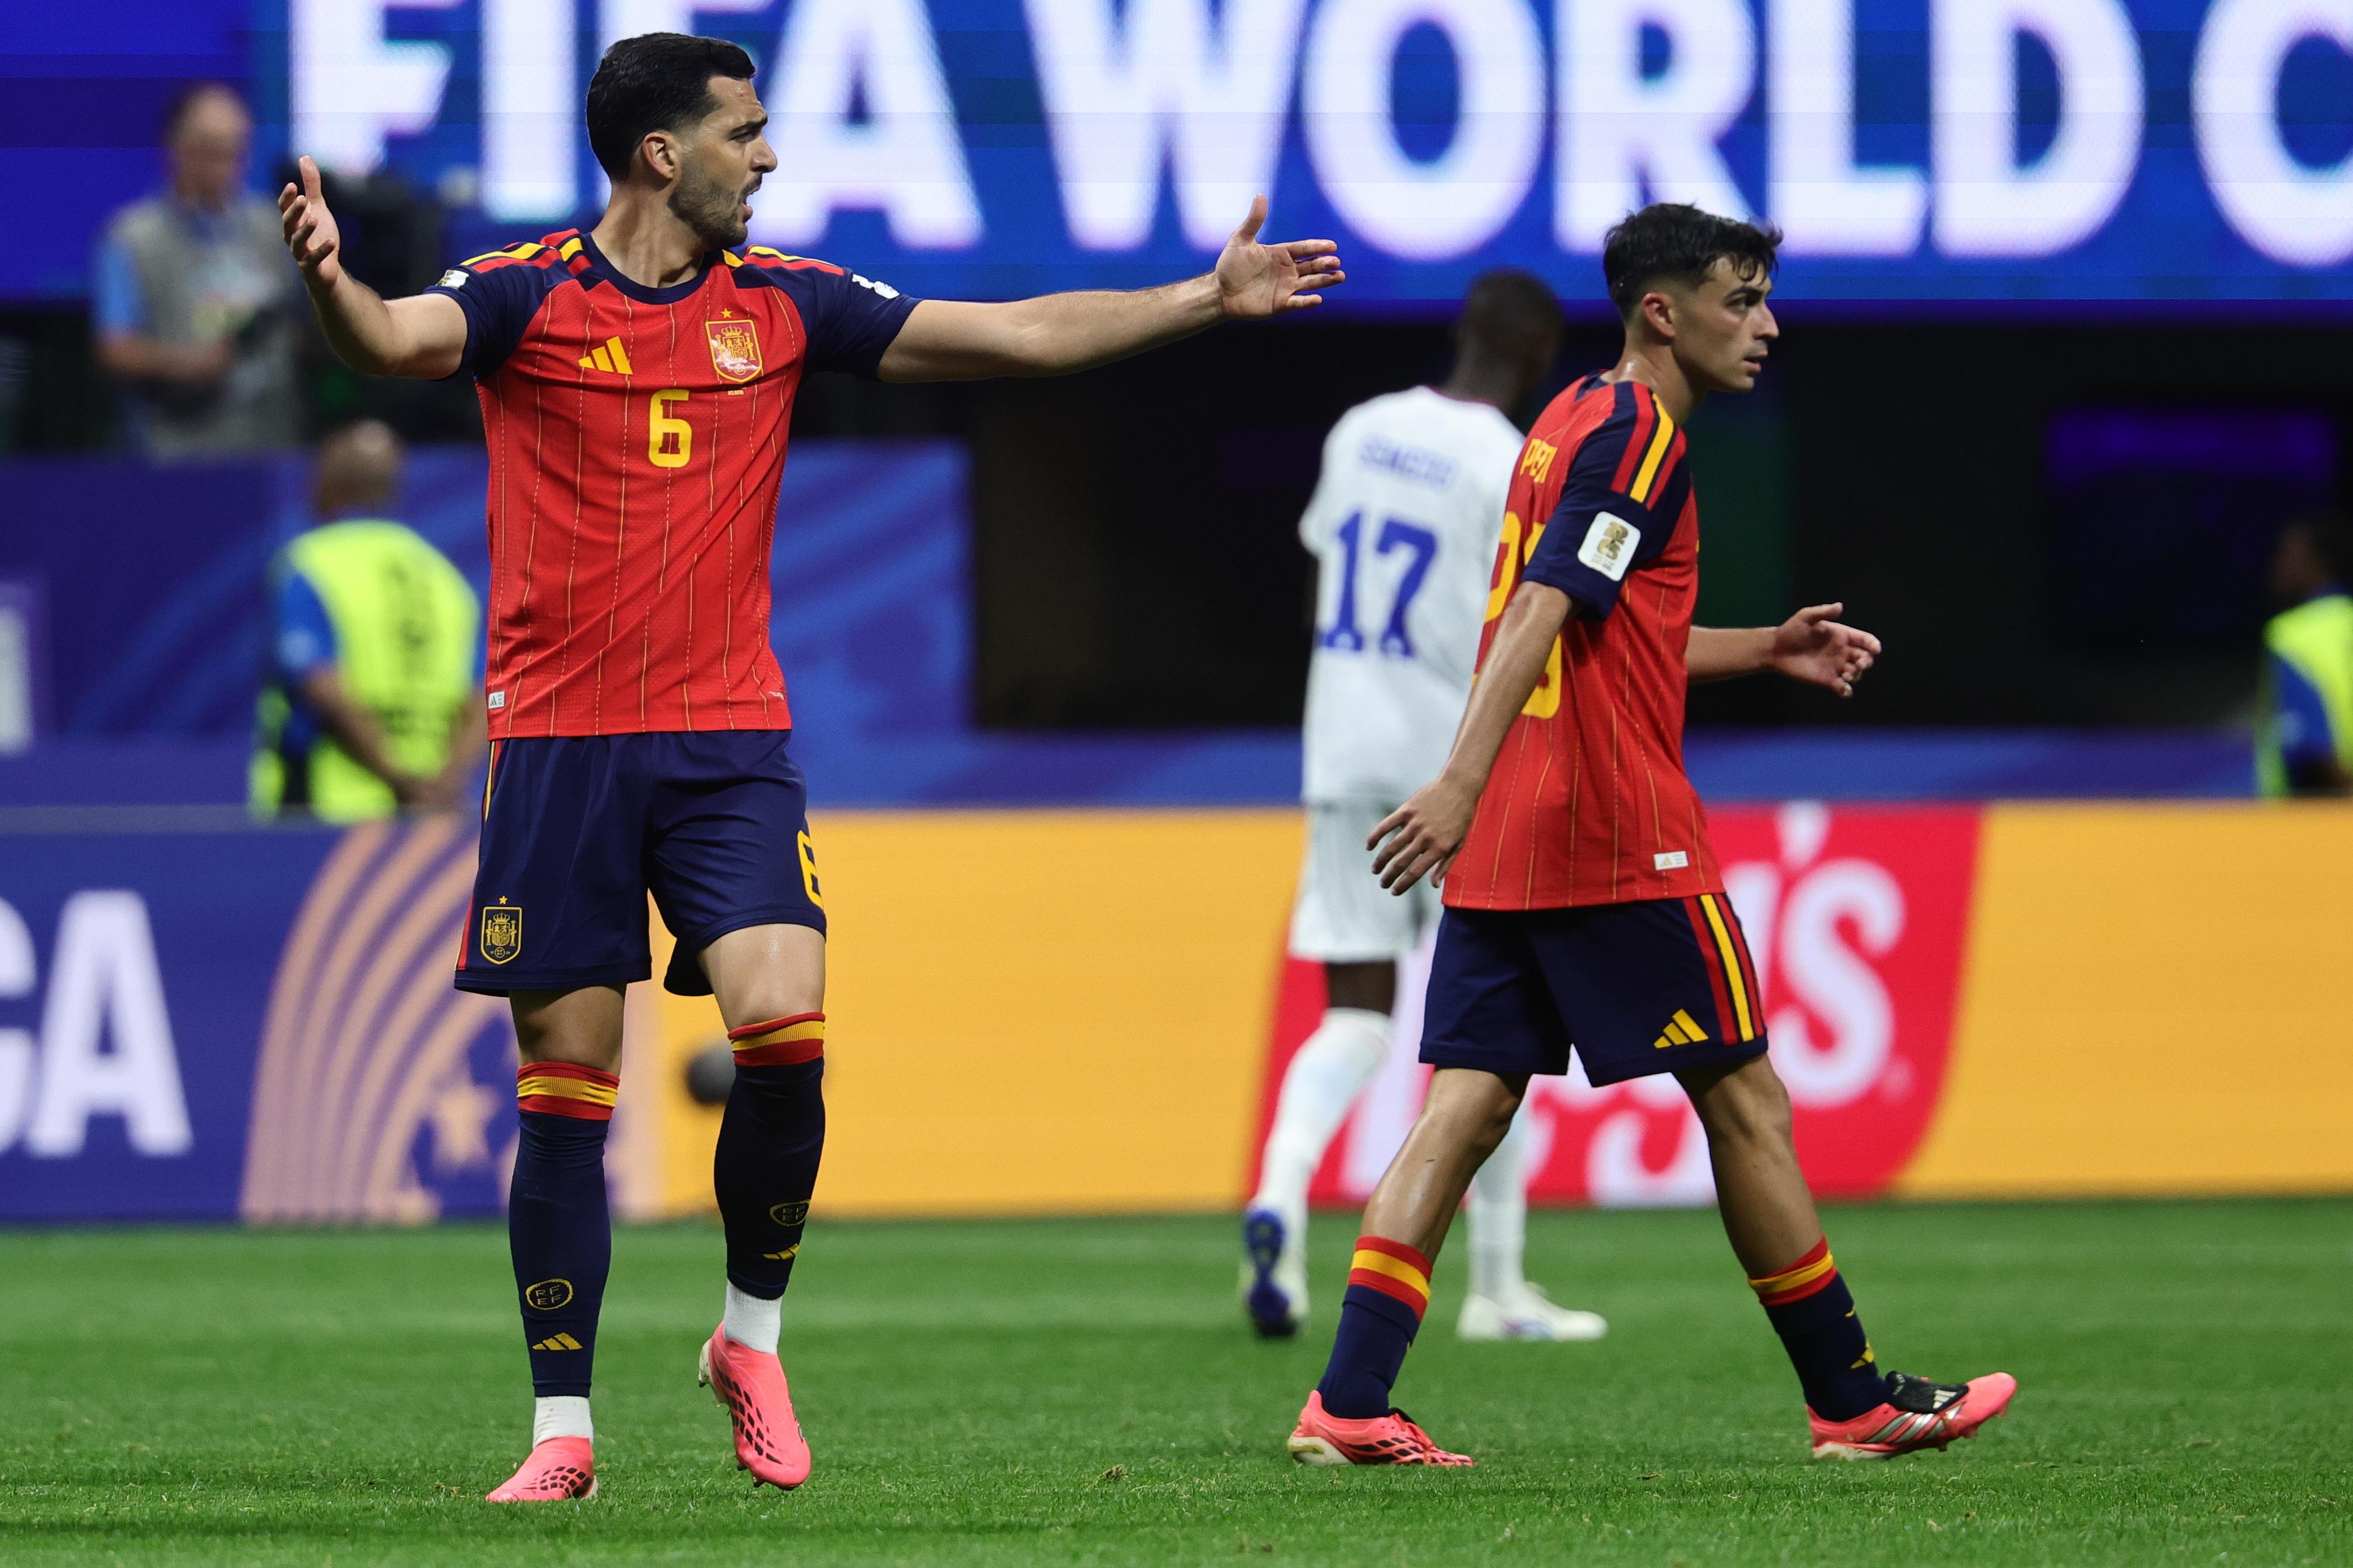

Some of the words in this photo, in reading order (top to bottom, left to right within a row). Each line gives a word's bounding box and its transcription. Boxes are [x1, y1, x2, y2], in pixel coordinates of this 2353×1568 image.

[1027, 0, 2145, 259] WORLD
[648, 389, 692, 468] 6
[1317, 507, 1437, 657] 17
